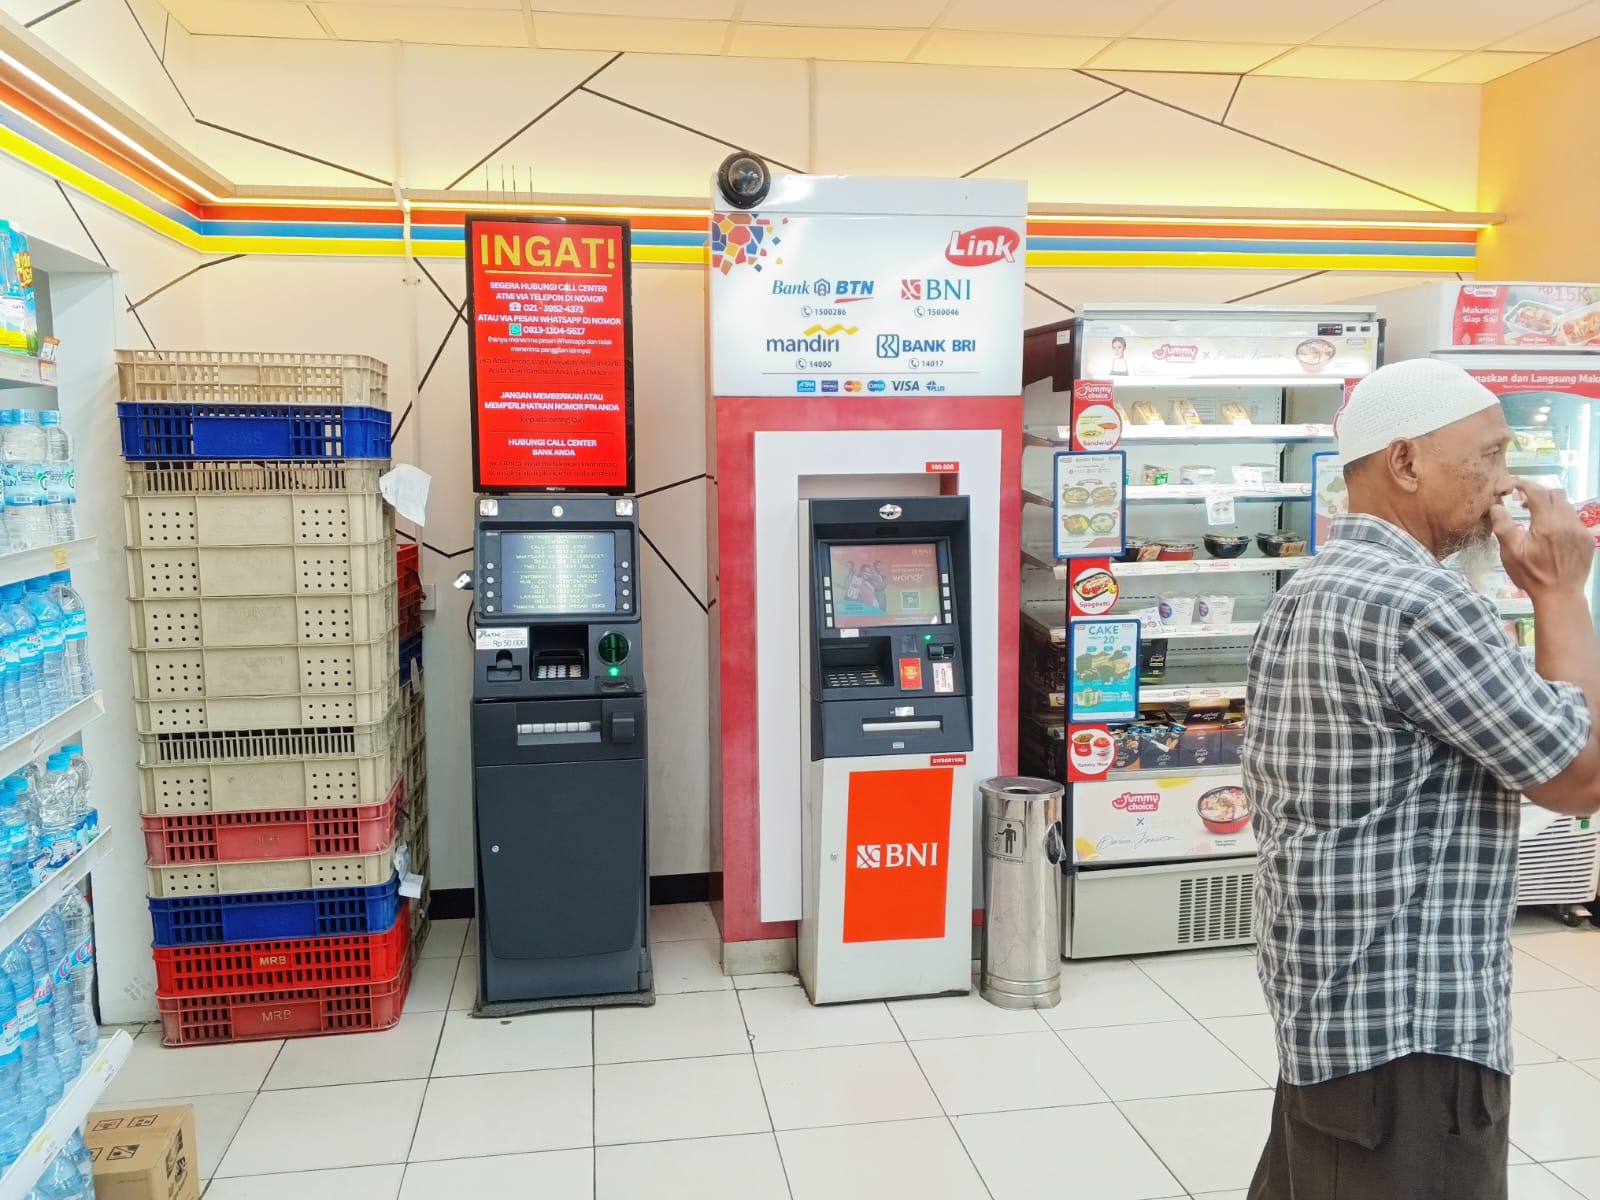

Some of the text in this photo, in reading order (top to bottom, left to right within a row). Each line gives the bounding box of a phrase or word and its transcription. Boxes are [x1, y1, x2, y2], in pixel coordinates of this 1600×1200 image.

[480, 234, 616, 269] INGAT!
[948, 230, 1016, 263] Link
[489, 281, 608, 293] SEGERA HUBUNGI CALL CENTER
[771, 279, 875, 295] Bank BTN
[926, 279, 971, 301] BNI
[530, 293, 564, 301] TELEPON
[565, 294, 574, 302] DI
[575, 295, 604, 303] NOMOR
[523, 303, 538, 312] 021
[814, 308, 847, 316] 1500286
[927, 308, 960, 316] 1500046
[1462, 306, 1499, 314] Makanan
[478, 313, 499, 321] ATAU
[500, 314, 513, 322] VIA
[514, 315, 539, 323] PESAN
[540, 316, 582, 324] WHATSAPP
[592, 317, 621, 325] NOMOR
[1463, 315, 1499, 324] Siap Saji
[766, 333, 840, 353] mandiri
[902, 339, 977, 353] BANK BRI
[1511, 374, 1528, 382] dan
[1531, 373, 1577, 385] Langsung
[891, 380, 920, 391] VISA
[1085, 384, 1112, 393] Yummy
[500, 391, 604, 401] JANGAN MEMBERIKAN ATAU
[484, 401, 620, 412] MEMPERLIHATKAN NOMOR PIN ANDA
[508, 438, 597, 448] HUBUNGI CALL CENTER
[532, 448, 576, 457] BANK ANDA
[1079, 601, 1111, 609] Spaghetti
[1088, 625, 1119, 635] CAKE
[492, 639, 527, 648] Rp 50.000
[1123, 792, 1160, 804] Yummy
[885, 842, 938, 868] BNI
[259, 955, 287, 966] MRB
[261, 1009, 292, 1023] MRB
